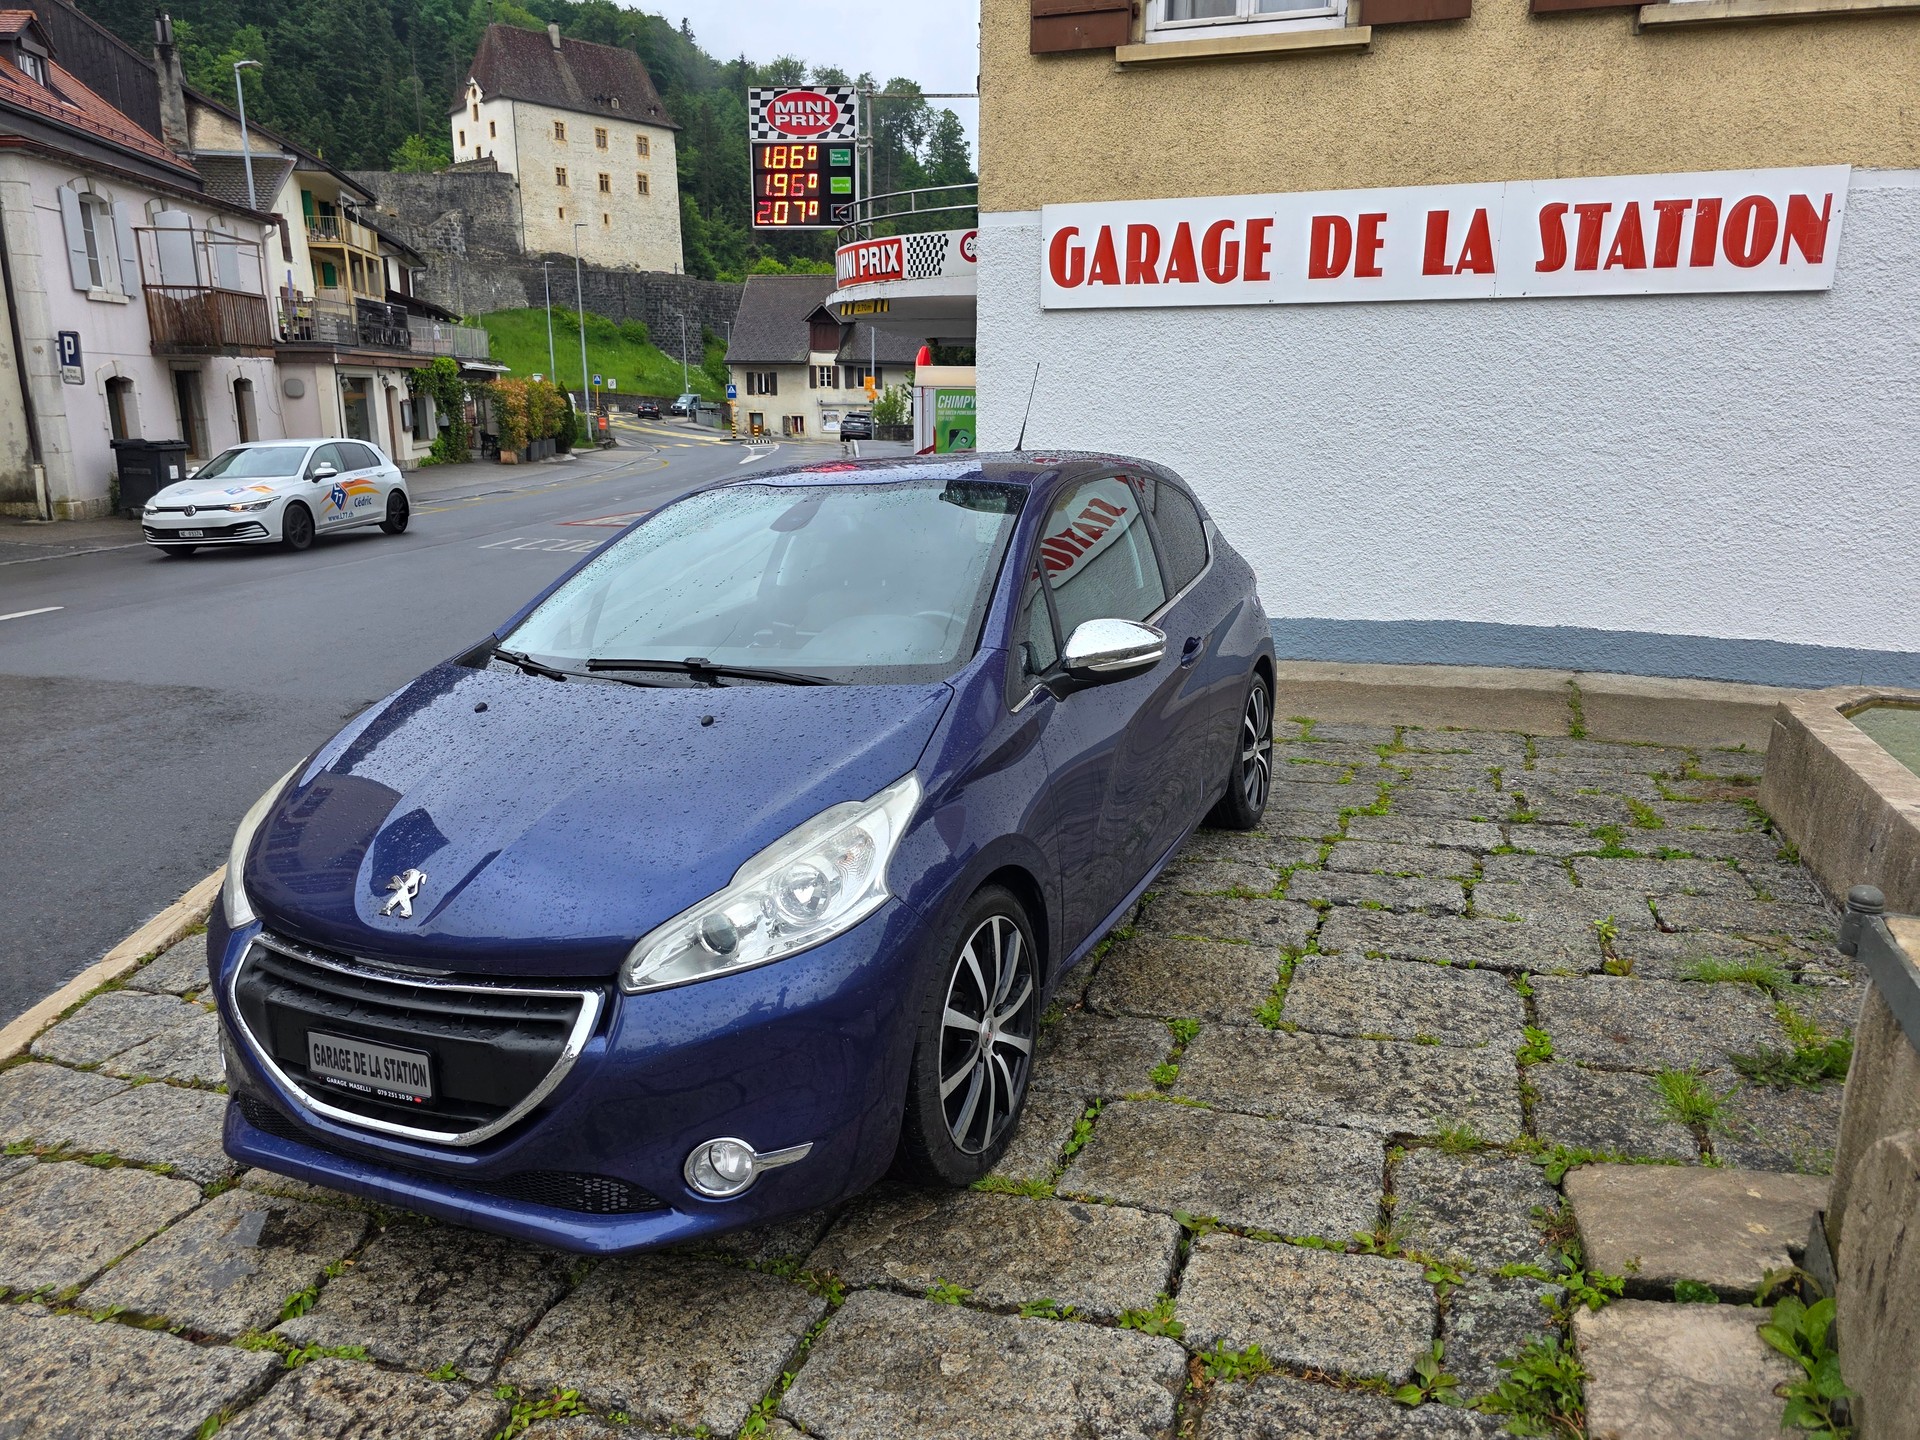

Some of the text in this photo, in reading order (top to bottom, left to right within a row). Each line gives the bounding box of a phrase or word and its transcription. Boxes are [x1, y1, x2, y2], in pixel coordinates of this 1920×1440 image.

[774, 101, 831, 114] MINI
[774, 114, 831, 127] PRIX
[1049, 193, 1833, 288] GARAGE DE LA STATION
[859, 243, 900, 277] PRIX
[64, 335, 75, 364] P
[937, 395, 976, 408] CHIMPY
[334, 491, 343, 505] 77
[354, 495, 372, 508] Cédric
[313, 1043, 427, 1088] GARAGE DE LA STATION
[326, 1077, 347, 1087] GARAGE
[349, 1082, 371, 1093] MASELLI
[377, 1089, 387, 1097] 079
[388, 1091, 397, 1099] 251
